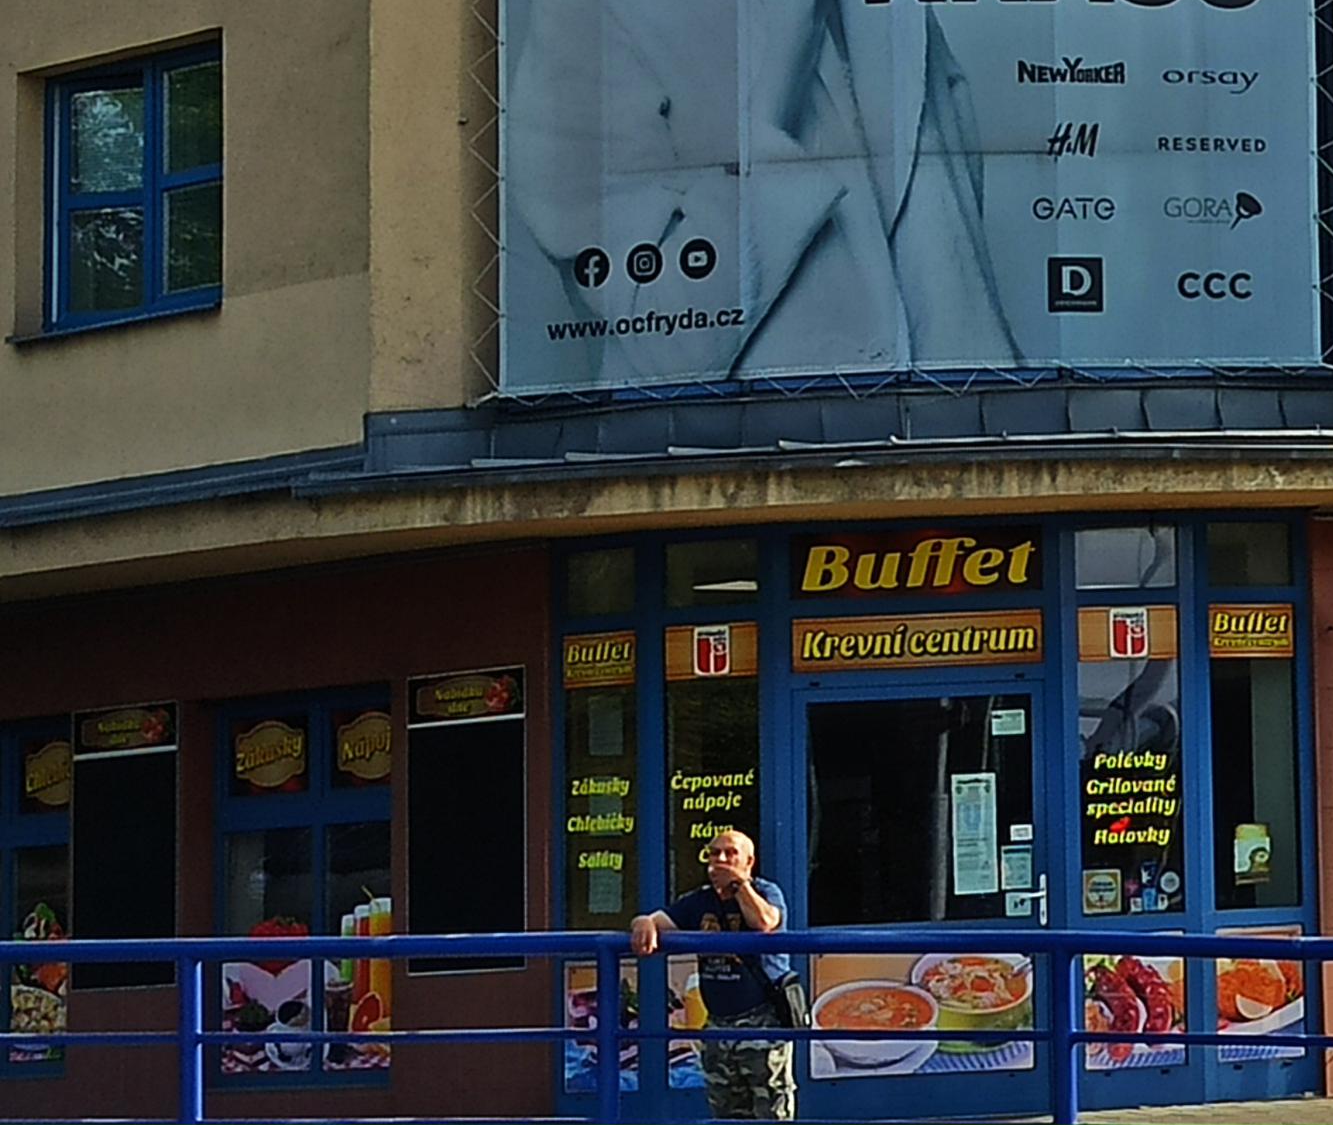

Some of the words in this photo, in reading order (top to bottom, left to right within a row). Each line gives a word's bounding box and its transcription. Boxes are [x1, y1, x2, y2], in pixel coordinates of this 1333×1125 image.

[1162, 70, 1259, 94] orsay
[1047, 123, 1100, 157] H&M
[1158, 137, 1266, 153] RESERVED
[1163, 197, 1233, 218] GORA
[1061, 265, 1092, 296] D
[1178, 272, 1252, 299] CCC
[547, 308, 745, 341] www.ocfryda.cz
[801, 537, 1037, 592] Buffet
[1213, 611, 1288, 633] Buffet
[567, 642, 630, 664] Buffet
[801, 624, 903, 660] Krevní
[904, 625, 1037, 655] centrum
[341, 725, 391, 765] Nápoj
[1094, 750, 1167, 770] Polévky
[571, 777, 630, 796] Zákusky
[670, 768, 755, 790] Čepované
[1086, 774, 1176, 795] Grilované
[682, 790, 742, 811] nápoje
[1086, 797, 1177, 818] speciality
